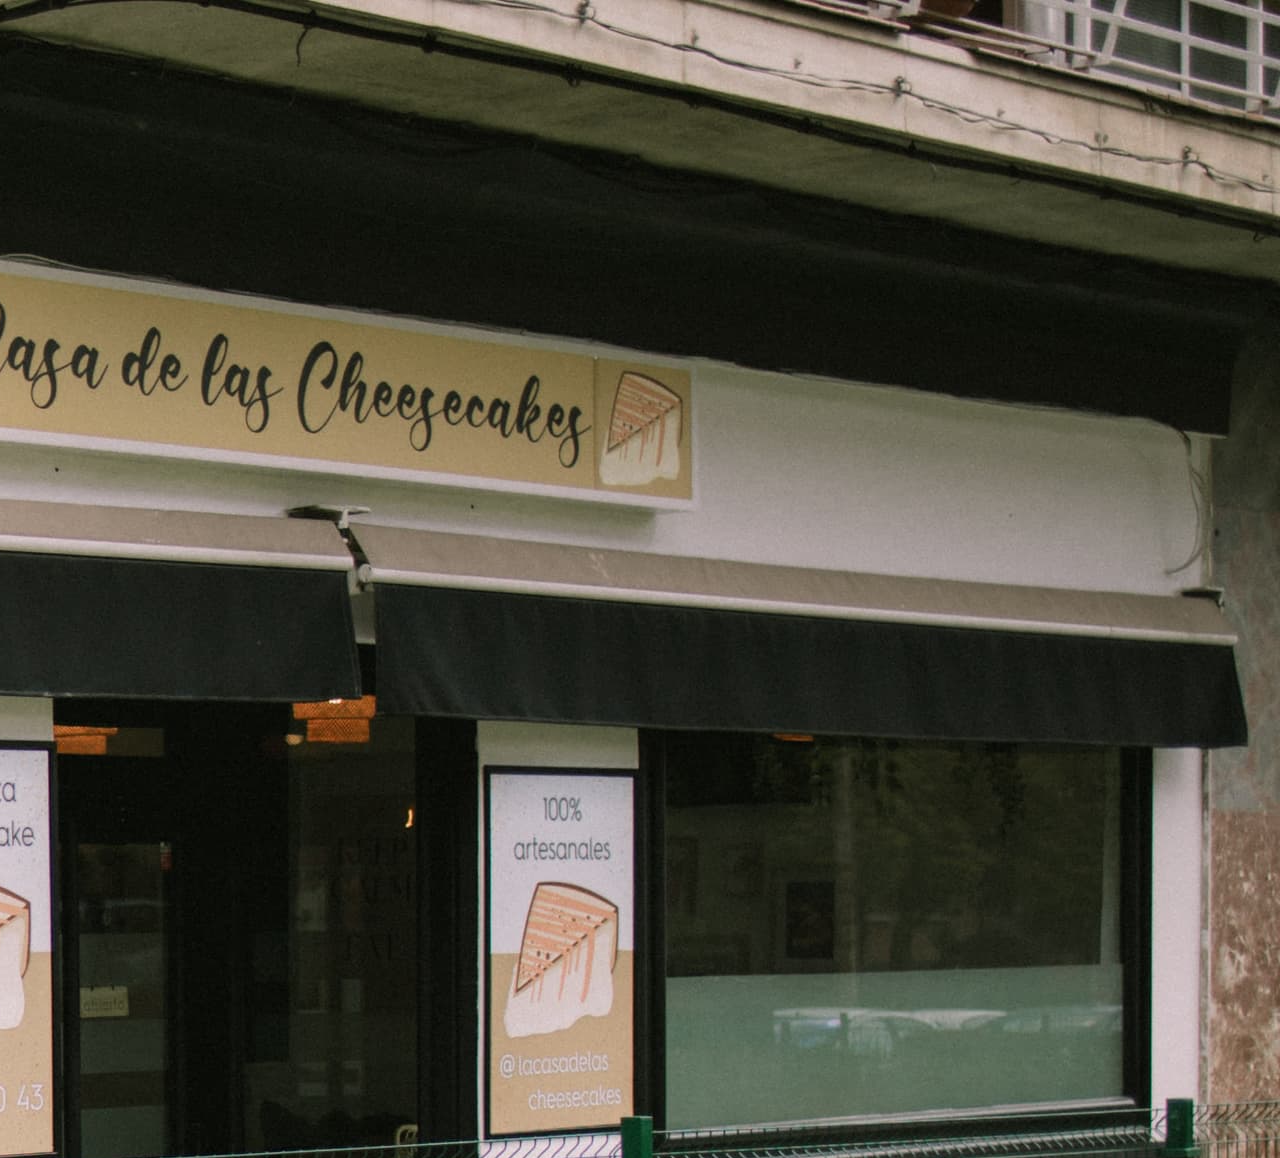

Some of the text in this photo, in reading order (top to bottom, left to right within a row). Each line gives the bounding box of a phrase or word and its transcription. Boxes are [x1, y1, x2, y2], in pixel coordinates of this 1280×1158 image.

[121, 327, 188, 396] de
[201, 333, 284, 433] las
[297, 341, 592, 468] Cheesecakes
[543, 797, 582, 821] 100%
[513, 837, 611, 860] artesanales
[17, 1084, 44, 1111] 43
[528, 1085, 621, 1110] cheesecakes
